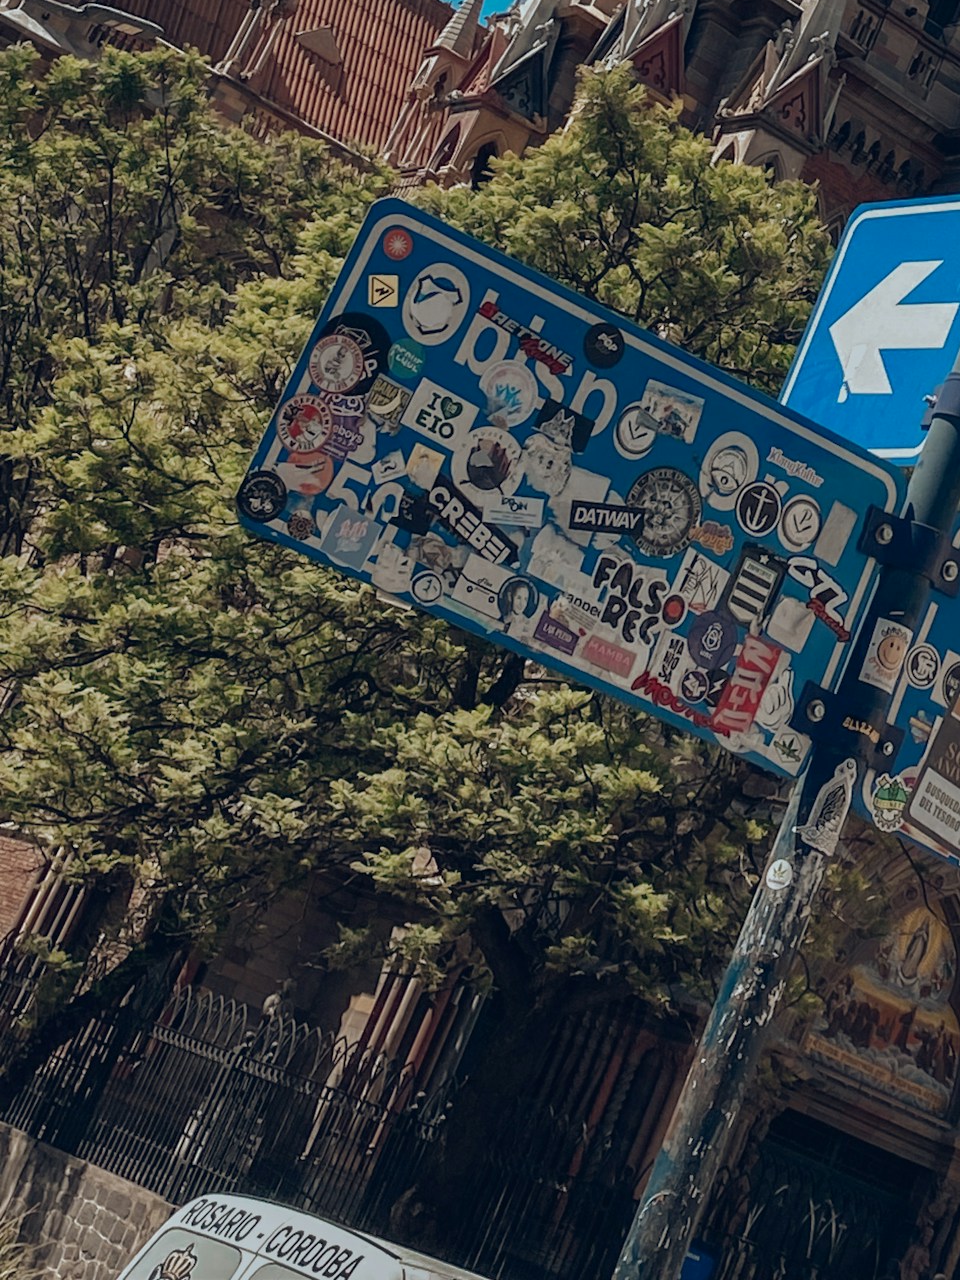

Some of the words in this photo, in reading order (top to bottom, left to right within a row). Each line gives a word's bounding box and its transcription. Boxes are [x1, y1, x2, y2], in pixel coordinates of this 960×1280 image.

[416, 409, 454, 439] EIO
[573, 506, 642, 529] DATWAY
[588, 640, 631, 666] MAMBA
[918, 796, 932, 814] DEL
[180, 1199, 261, 1242] ROSARIO
[265, 1226, 364, 1280] CORDOBA
